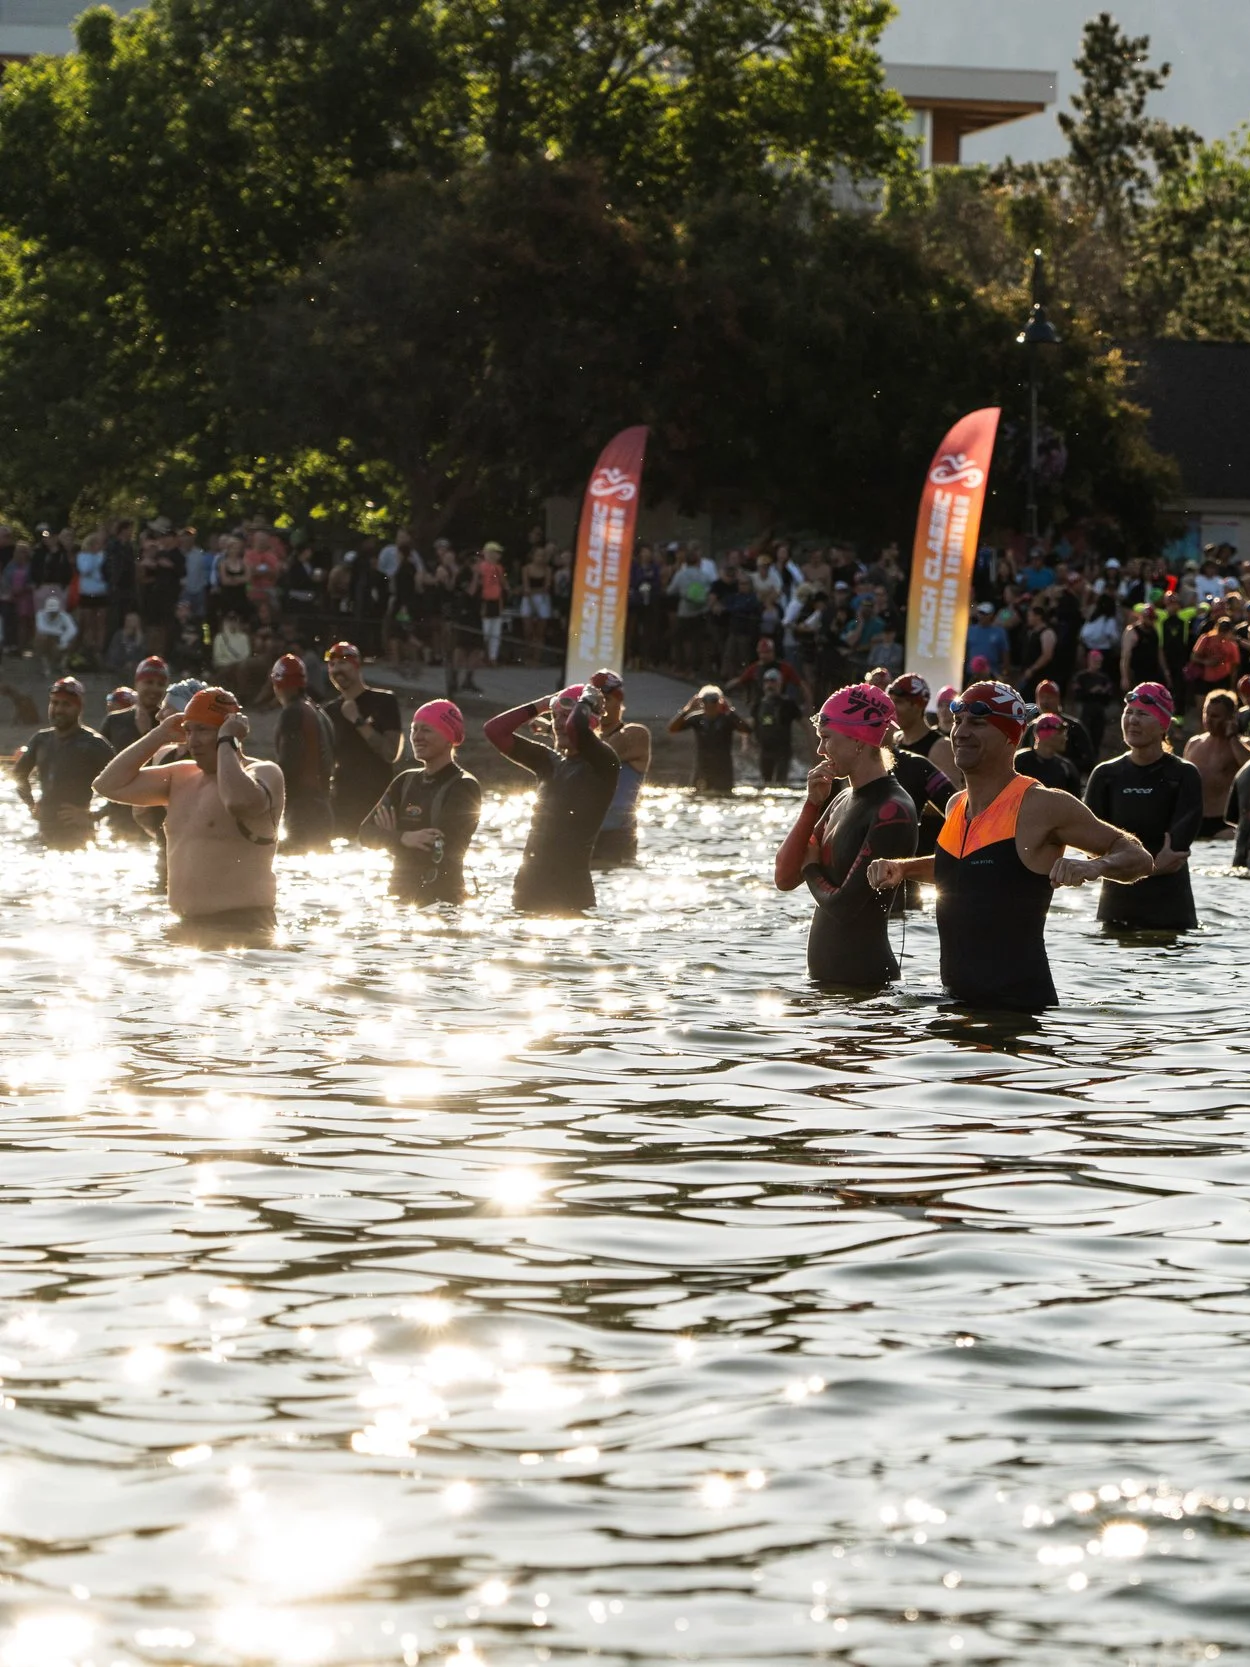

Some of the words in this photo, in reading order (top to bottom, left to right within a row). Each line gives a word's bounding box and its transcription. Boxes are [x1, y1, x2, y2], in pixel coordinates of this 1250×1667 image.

[923, 488, 953, 581] CLASSIC
[917, 585, 939, 658] PEACH
[842, 697, 884, 727] 70
[849, 689, 890, 713] BLUE
